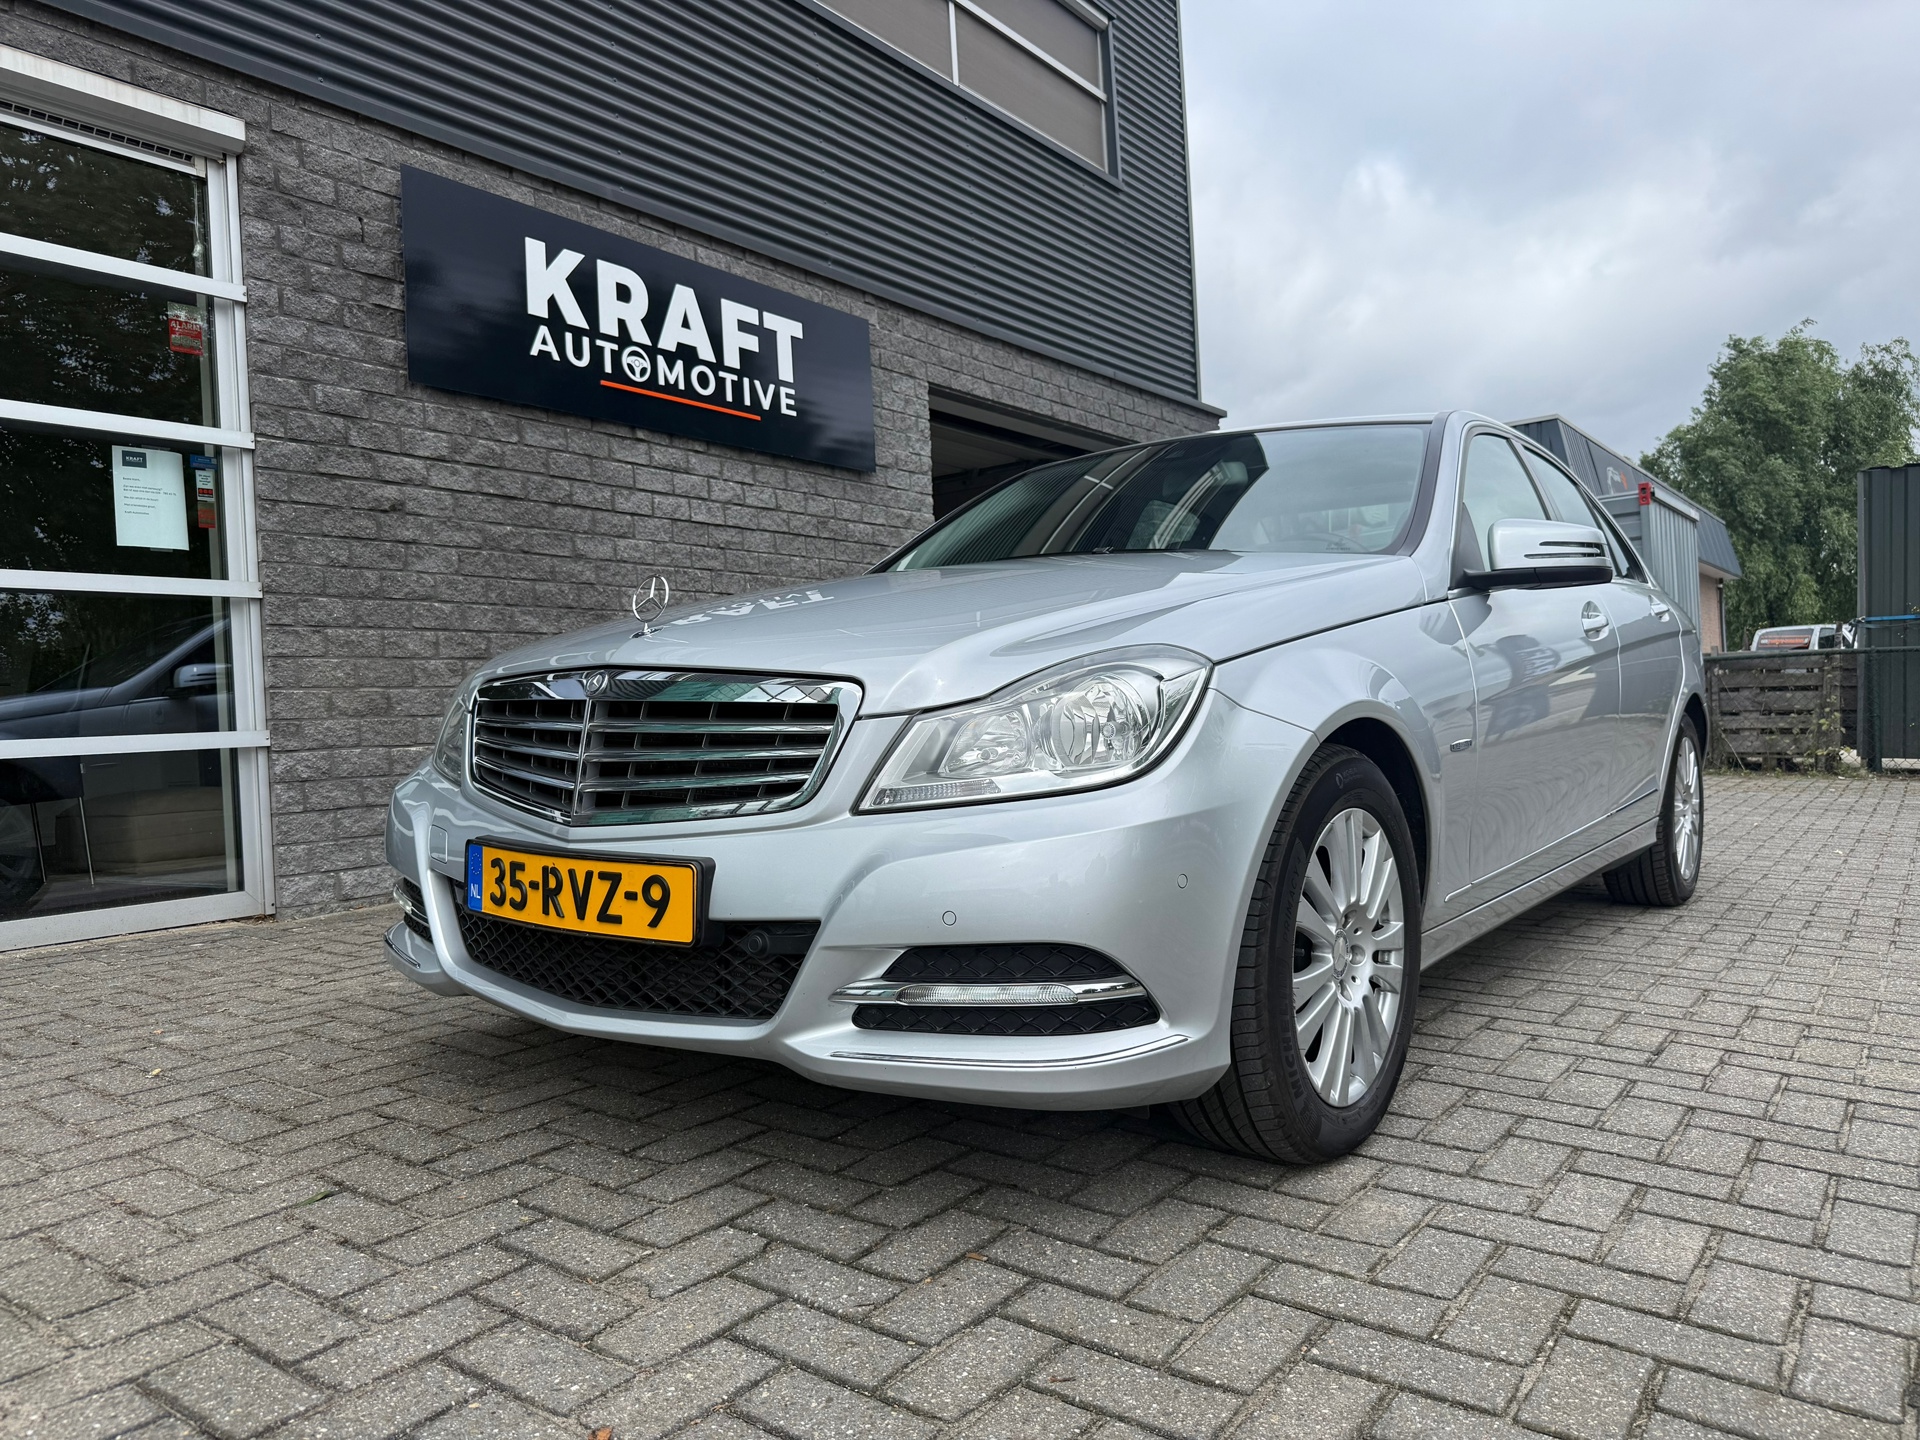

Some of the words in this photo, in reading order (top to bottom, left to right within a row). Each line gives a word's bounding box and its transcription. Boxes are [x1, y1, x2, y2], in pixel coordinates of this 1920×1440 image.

[170, 320, 201, 331] ALARM
[524, 236, 804, 383] KRAFT
[529, 325, 798, 417] AUTOMOTIVE
[125, 455, 143, 463] KRAFT
[470, 883, 481, 899] NL
[489, 857, 671, 929] 35-RVZ-9
[1282, 866, 1300, 943] PRIMACY
[1278, 958, 1304, 1100] MICHELIN
